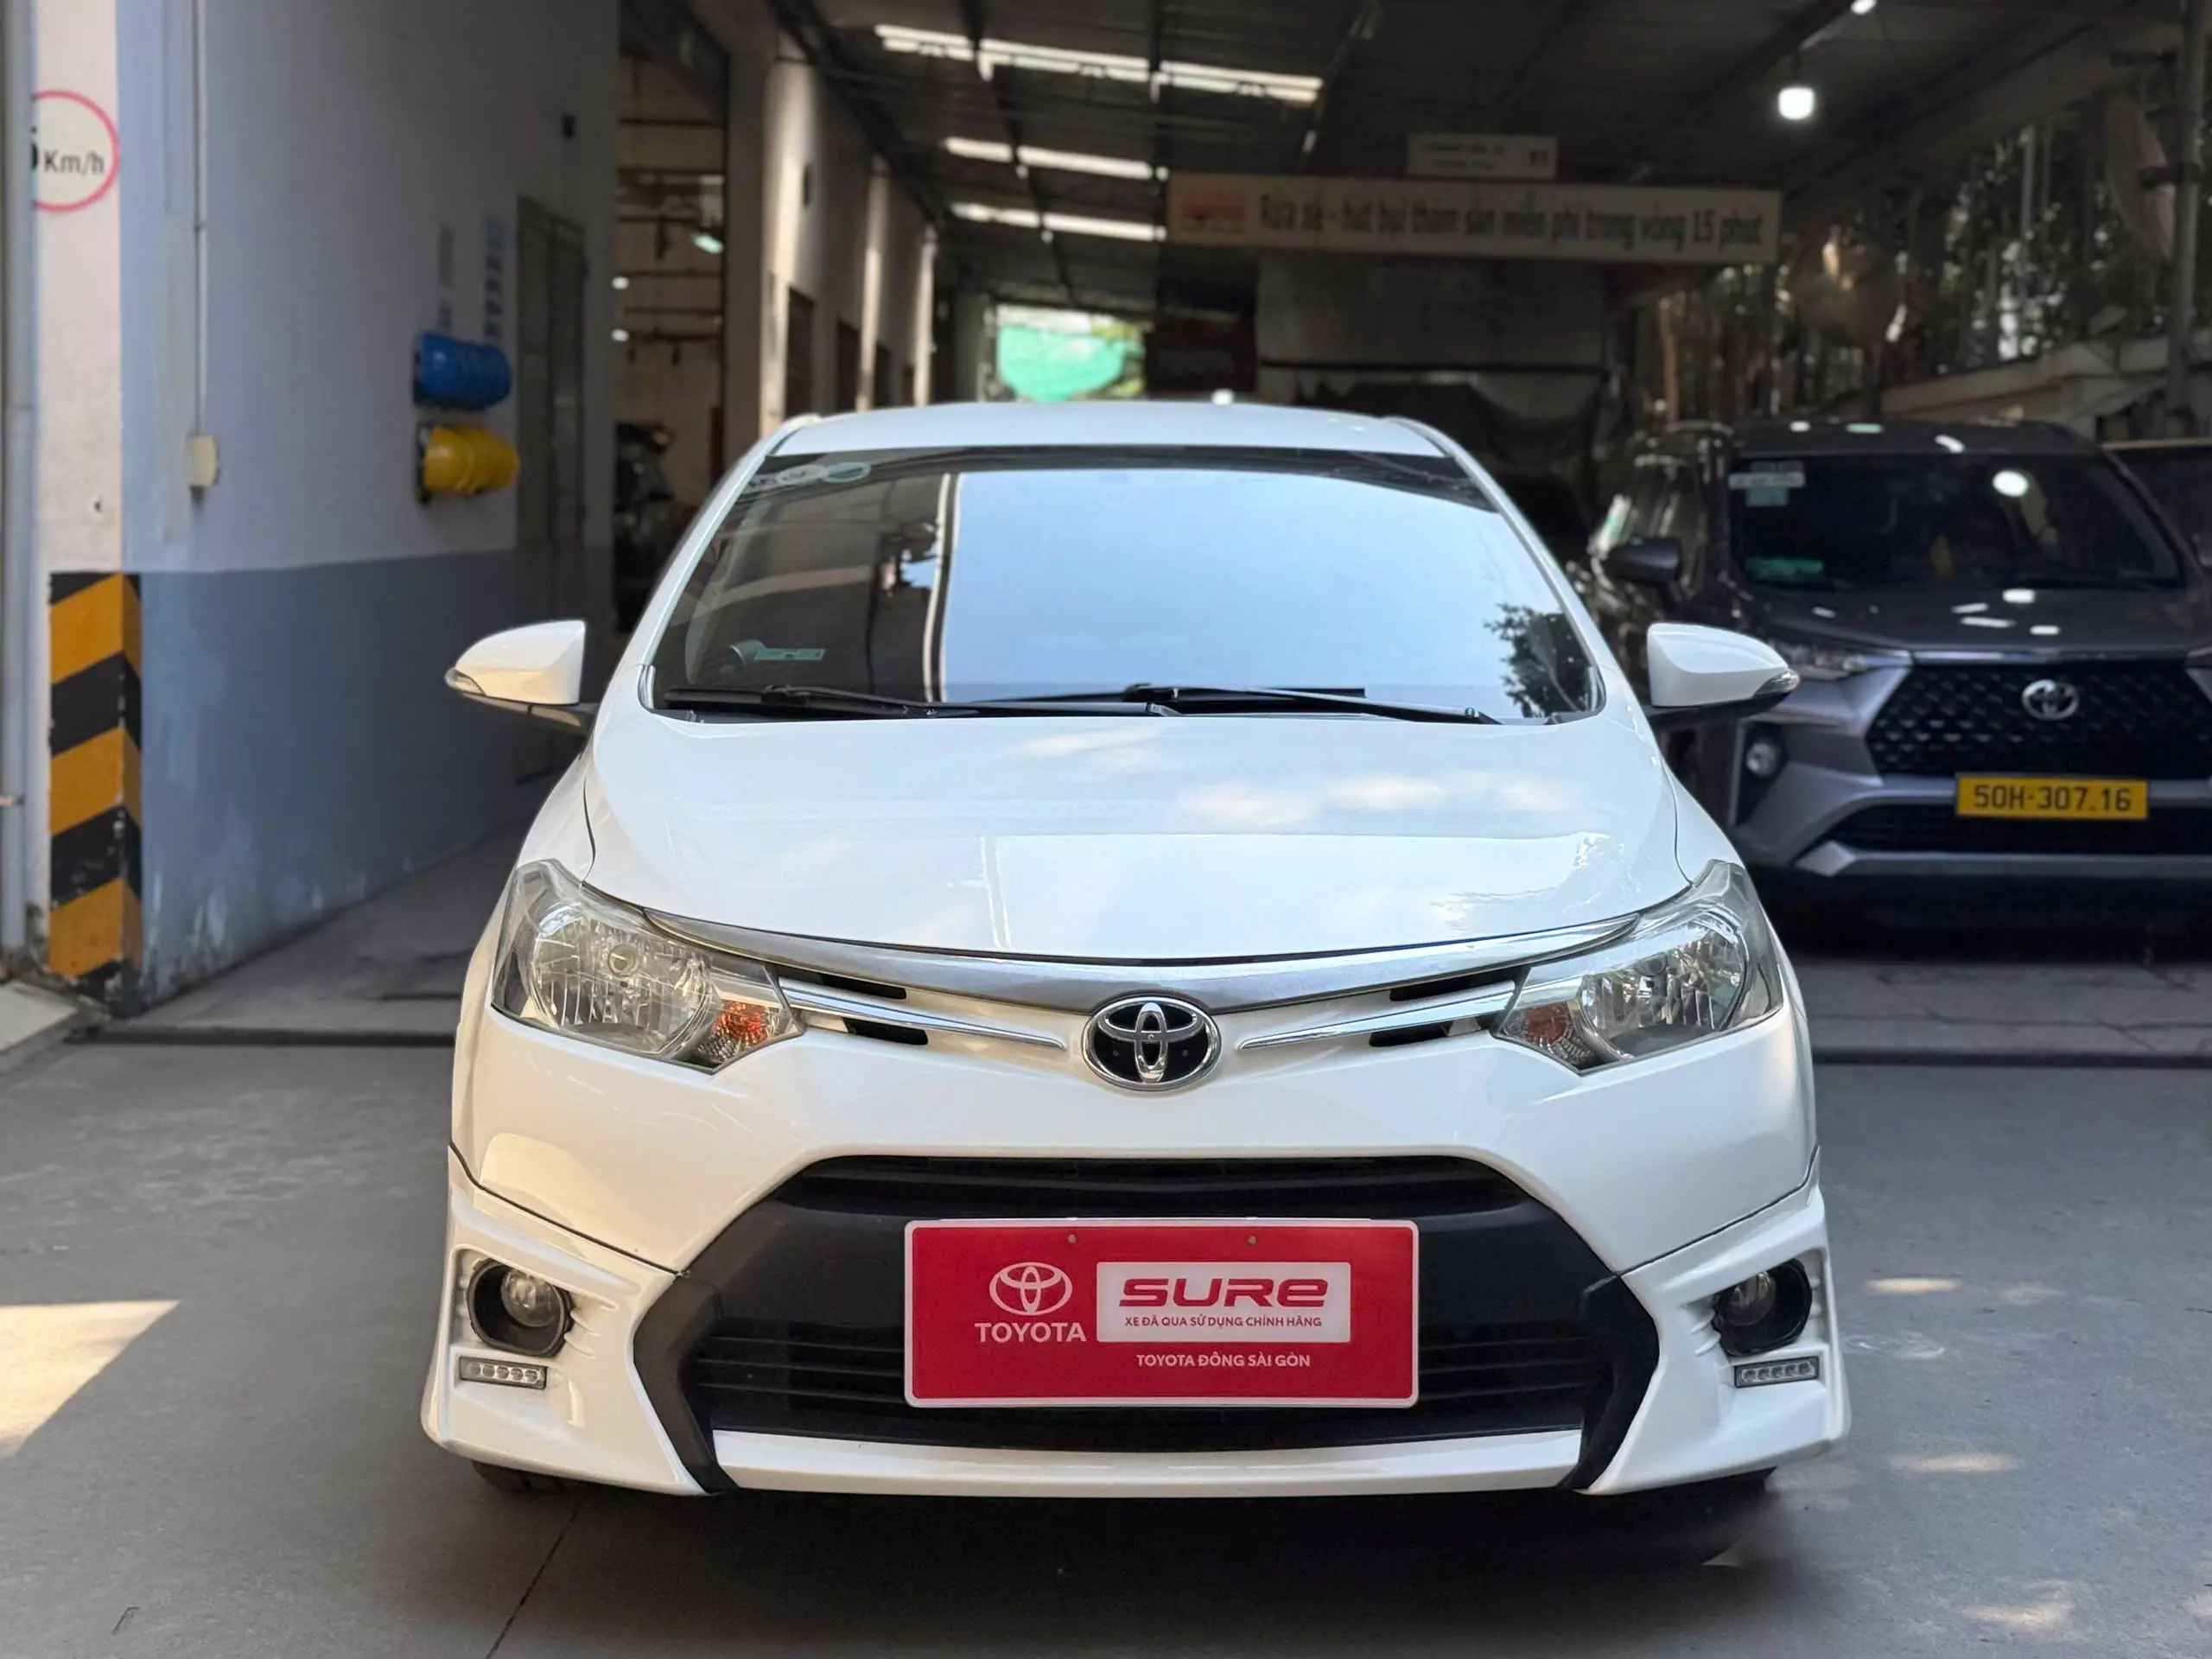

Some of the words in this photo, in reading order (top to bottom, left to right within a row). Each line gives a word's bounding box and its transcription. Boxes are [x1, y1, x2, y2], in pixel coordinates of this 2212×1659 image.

[44, 149, 105, 177] Km/h
[1690, 208, 1714, 243] 15
[1973, 784, 2132, 812] 50H-307.16
[974, 1322, 1087, 1343] TOYOTA
[1125, 1317, 1140, 1326] XE
[1141, 1314, 1159, 1326] ĐÃ
[1161, 1316, 1187, 1326] QUA
[1190, 1313, 1206, 1326] SỬ
[1208, 1316, 1243, 1329] DỤNG
[1245, 1314, 1284, 1326] CHÍNH
[1136, 1354, 1196, 1367] TOYOTA
[1198, 1351, 1245, 1367] ĐÔNG
[1248, 1351, 1272, 1367] SÀI
[1274, 1351, 1311, 1367] GÒN
